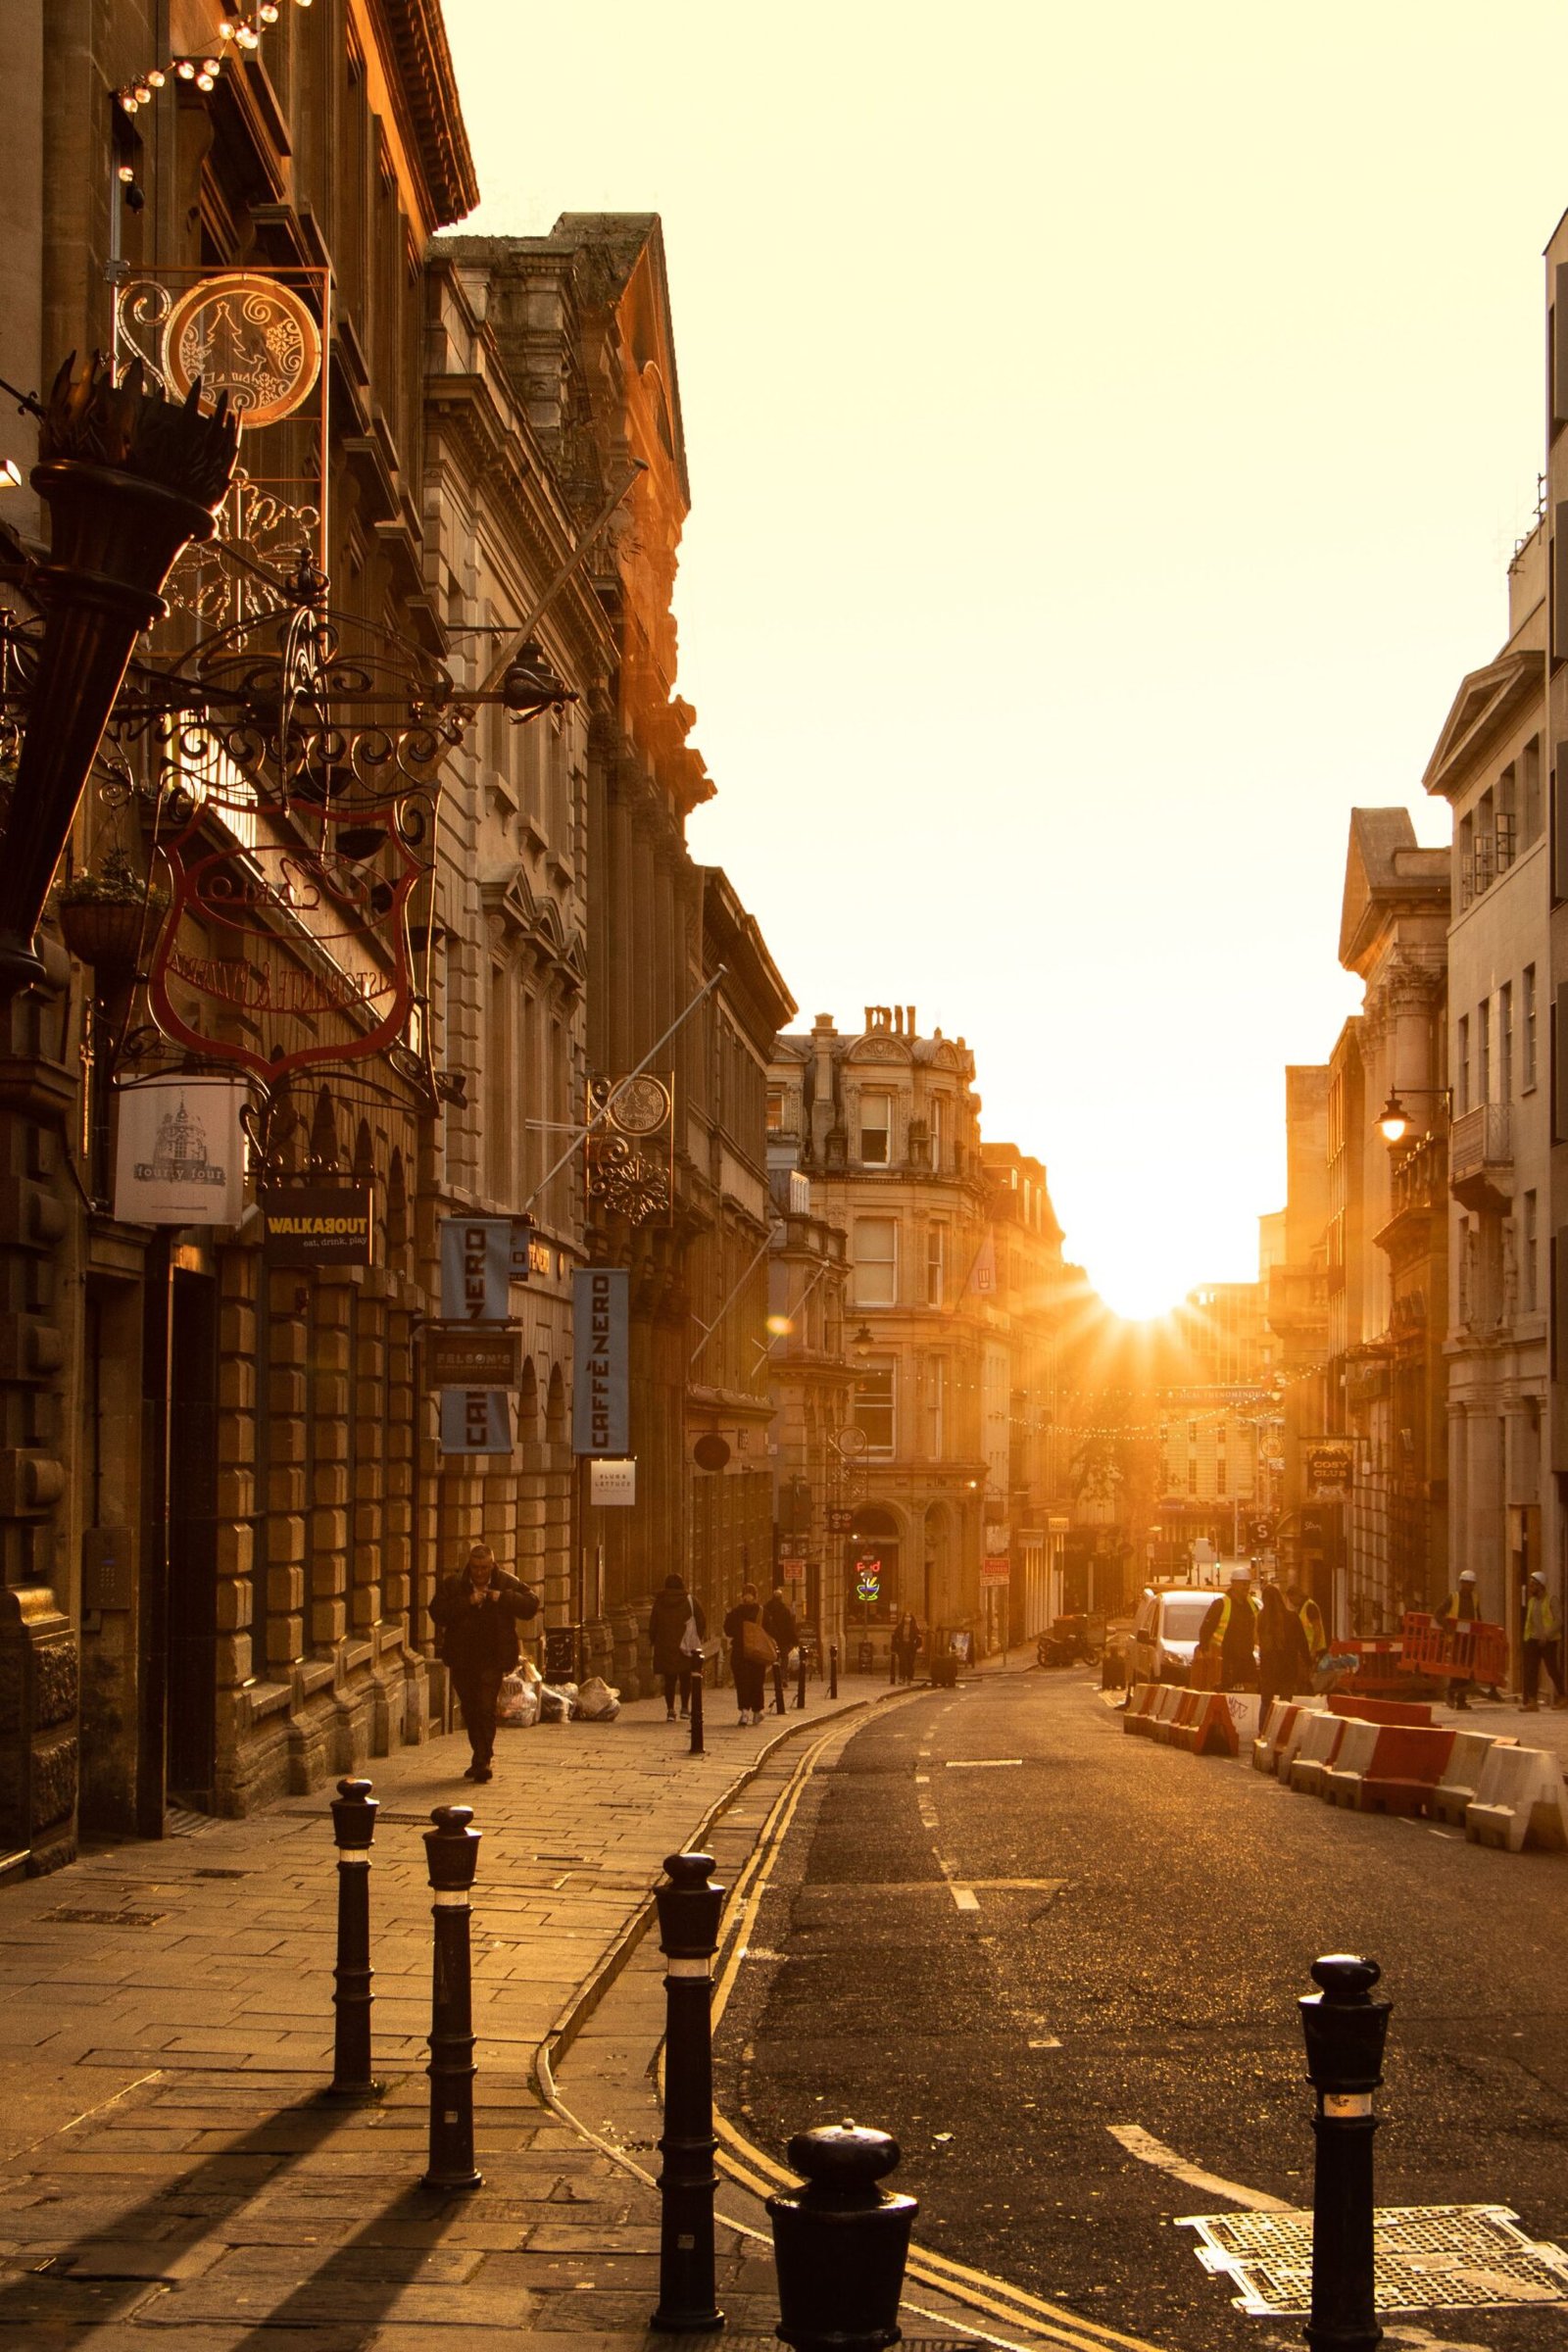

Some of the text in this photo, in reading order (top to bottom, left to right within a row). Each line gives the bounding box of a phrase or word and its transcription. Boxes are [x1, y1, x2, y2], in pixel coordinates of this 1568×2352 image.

[191, 1166, 223, 1179] four
[268, 1217, 368, 1234] WALKABOUT
[349, 1237, 368, 1248] play
[592, 1275, 610, 1355] NERO
[436, 1352, 511, 1364] FELSON'S
[1313, 1460, 1348, 1469] COSY
[1313, 1469, 1348, 1478] CLUB
